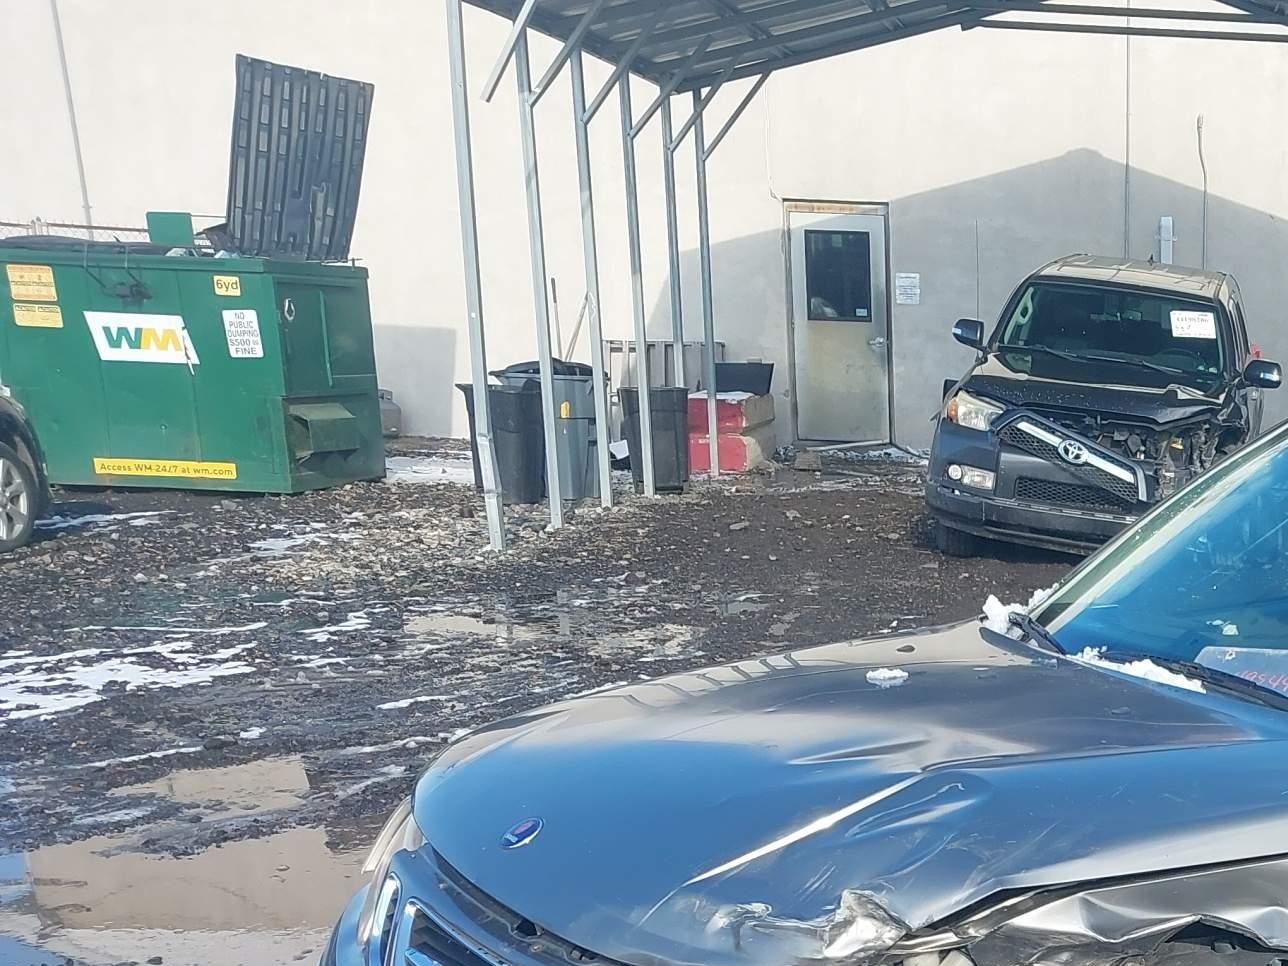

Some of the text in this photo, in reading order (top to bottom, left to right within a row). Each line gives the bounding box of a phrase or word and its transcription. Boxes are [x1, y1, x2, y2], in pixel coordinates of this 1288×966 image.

[216, 279, 239, 292] 6yd
[234, 312, 245, 320] NO
[228, 320, 254, 328] PUBLIC
[227, 329, 259, 338] DUMPING
[102, 326, 183, 351] WM
[235, 347, 257, 355] FINE
[100, 463, 132, 472] Access
[181, 466, 190, 474] at
[193, 468, 234, 476] wm.com
